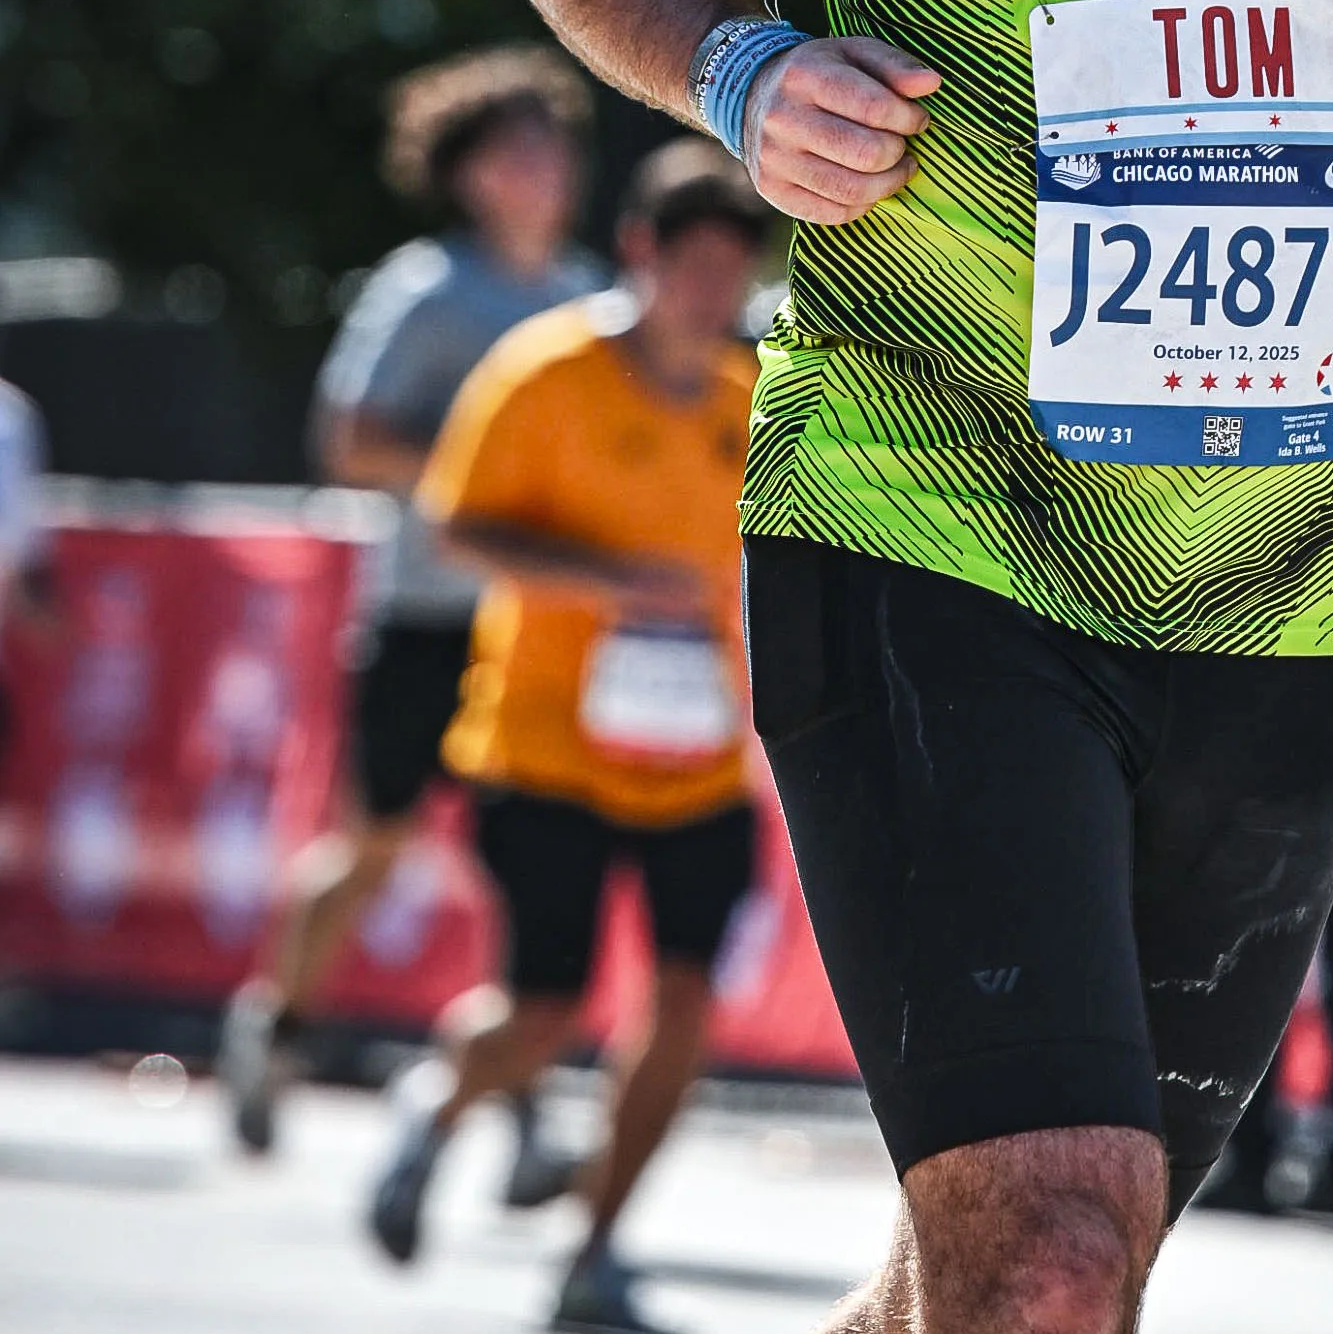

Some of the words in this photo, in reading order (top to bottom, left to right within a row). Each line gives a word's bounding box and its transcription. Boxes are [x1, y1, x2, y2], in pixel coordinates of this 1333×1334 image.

[1152, 6, 1295, 98] TOM
[1113, 147, 1154, 159] BANK
[1159, 148, 1178, 158] OF
[1182, 147, 1252, 159] AMERICA
[1113, 165, 1193, 182] CHICAGO
[1199, 165, 1298, 183] MARATHON
[1154, 345, 1222, 360] October
[1228, 346, 1253, 362] 12,
[1259, 346, 1300, 360] 2025
[1057, 425, 1104, 443] ROW
[1110, 427, 1132, 444] 31
[1288, 433, 1311, 445] Gate
[1313, 430, 1320, 442] 4
[1278, 447, 1292, 457] Ida
[1294, 447, 1302, 456] B.
[1305, 443, 1326, 455] Wells
